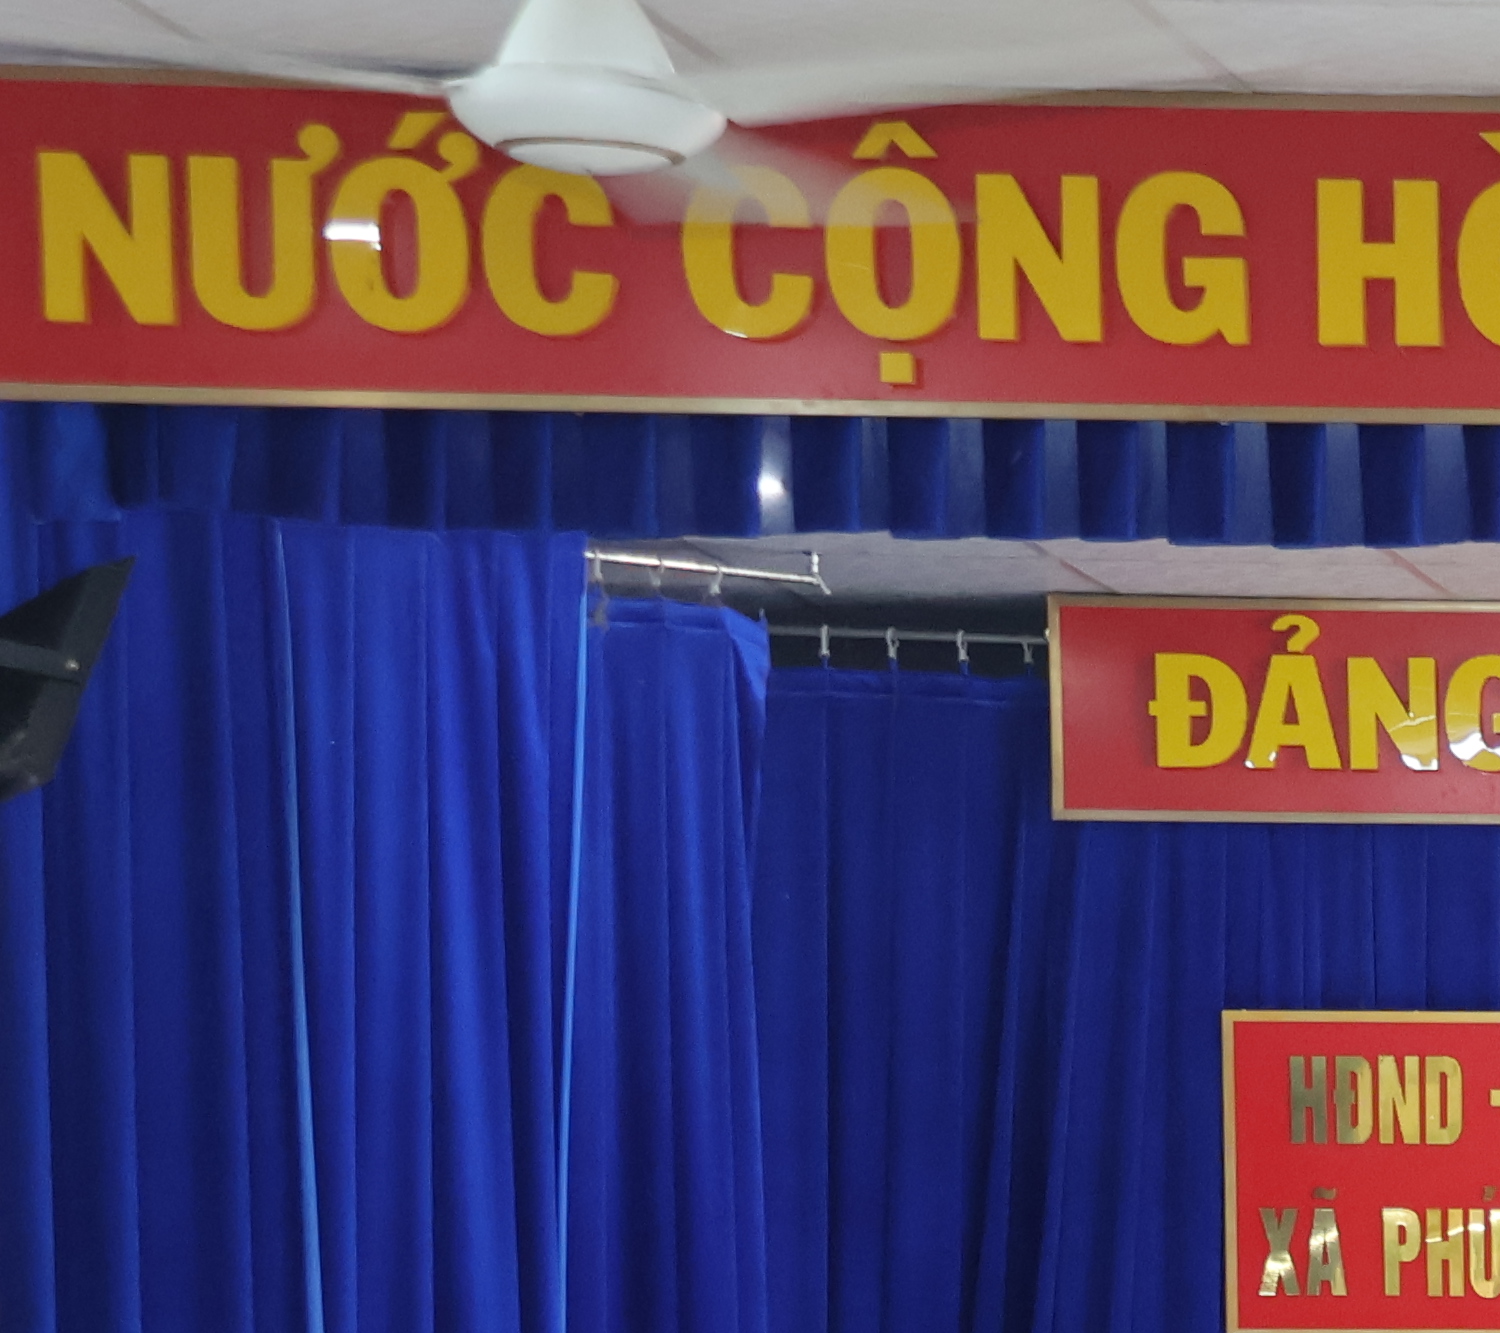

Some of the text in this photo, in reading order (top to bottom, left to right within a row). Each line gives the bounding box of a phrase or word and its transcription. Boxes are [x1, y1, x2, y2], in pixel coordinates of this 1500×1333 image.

[40, 112, 615, 335] NƯỚC
[681, 121, 1250, 384] CỘNG
[1288, 1054, 1465, 1146] HĐND
[1257, 1186, 1348, 1297] XÃ
